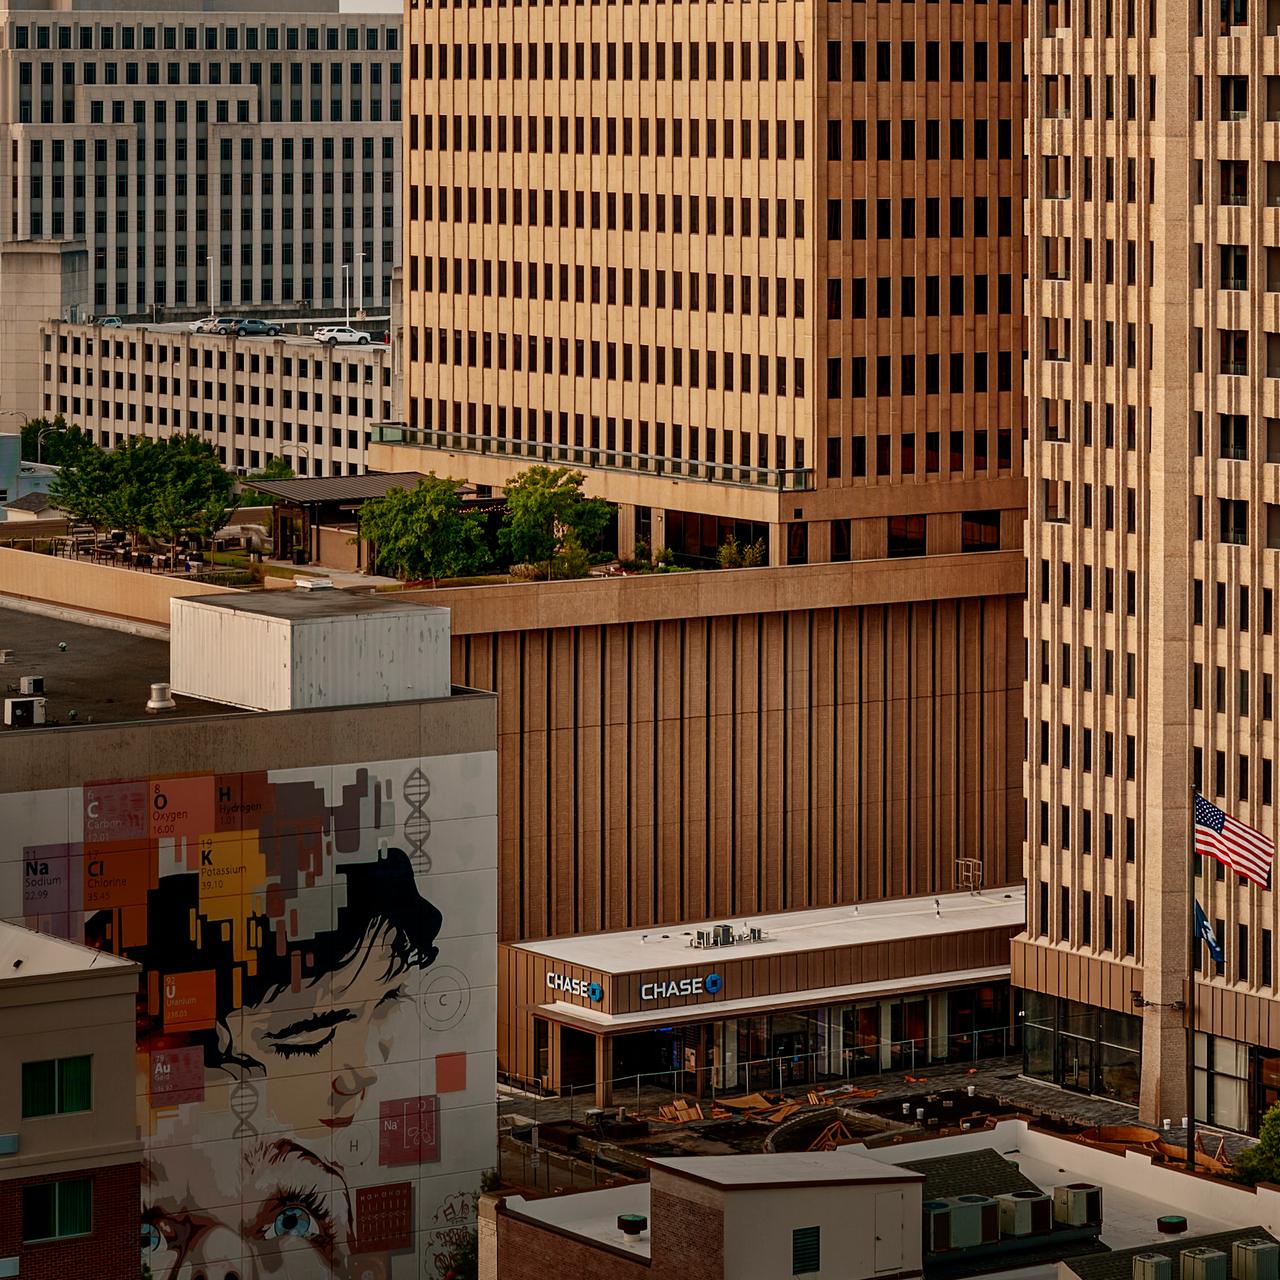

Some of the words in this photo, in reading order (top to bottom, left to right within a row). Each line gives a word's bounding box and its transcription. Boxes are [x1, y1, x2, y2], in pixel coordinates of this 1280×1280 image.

[154, 784, 161, 794] 8
[219, 786, 231, 803] H
[153, 793, 168, 810] O
[87, 801, 100, 818] C
[219, 802, 262, 815] Hydrogen
[152, 810, 189, 823] Oxygen
[87, 818, 122, 830] Carbon
[153, 824, 175, 834] 16.00
[201, 850, 213, 866] K
[25, 861, 50, 877] Na
[87, 860, 105, 878] Cl
[201, 865, 248, 877] Potassium
[24, 875, 62, 889] Sodium
[87, 877, 127, 889] Chlorine
[201, 880, 224, 890] 39.10
[24, 889, 49, 901] 22.99
[547, 972, 589, 997] CHASE
[641, 977, 703, 1000] CHASE
[166, 985, 176, 999] U
[439, 994, 448, 1006] C
[154, 1063, 171, 1074] Au
[349, 1139, 359, 1153] H
